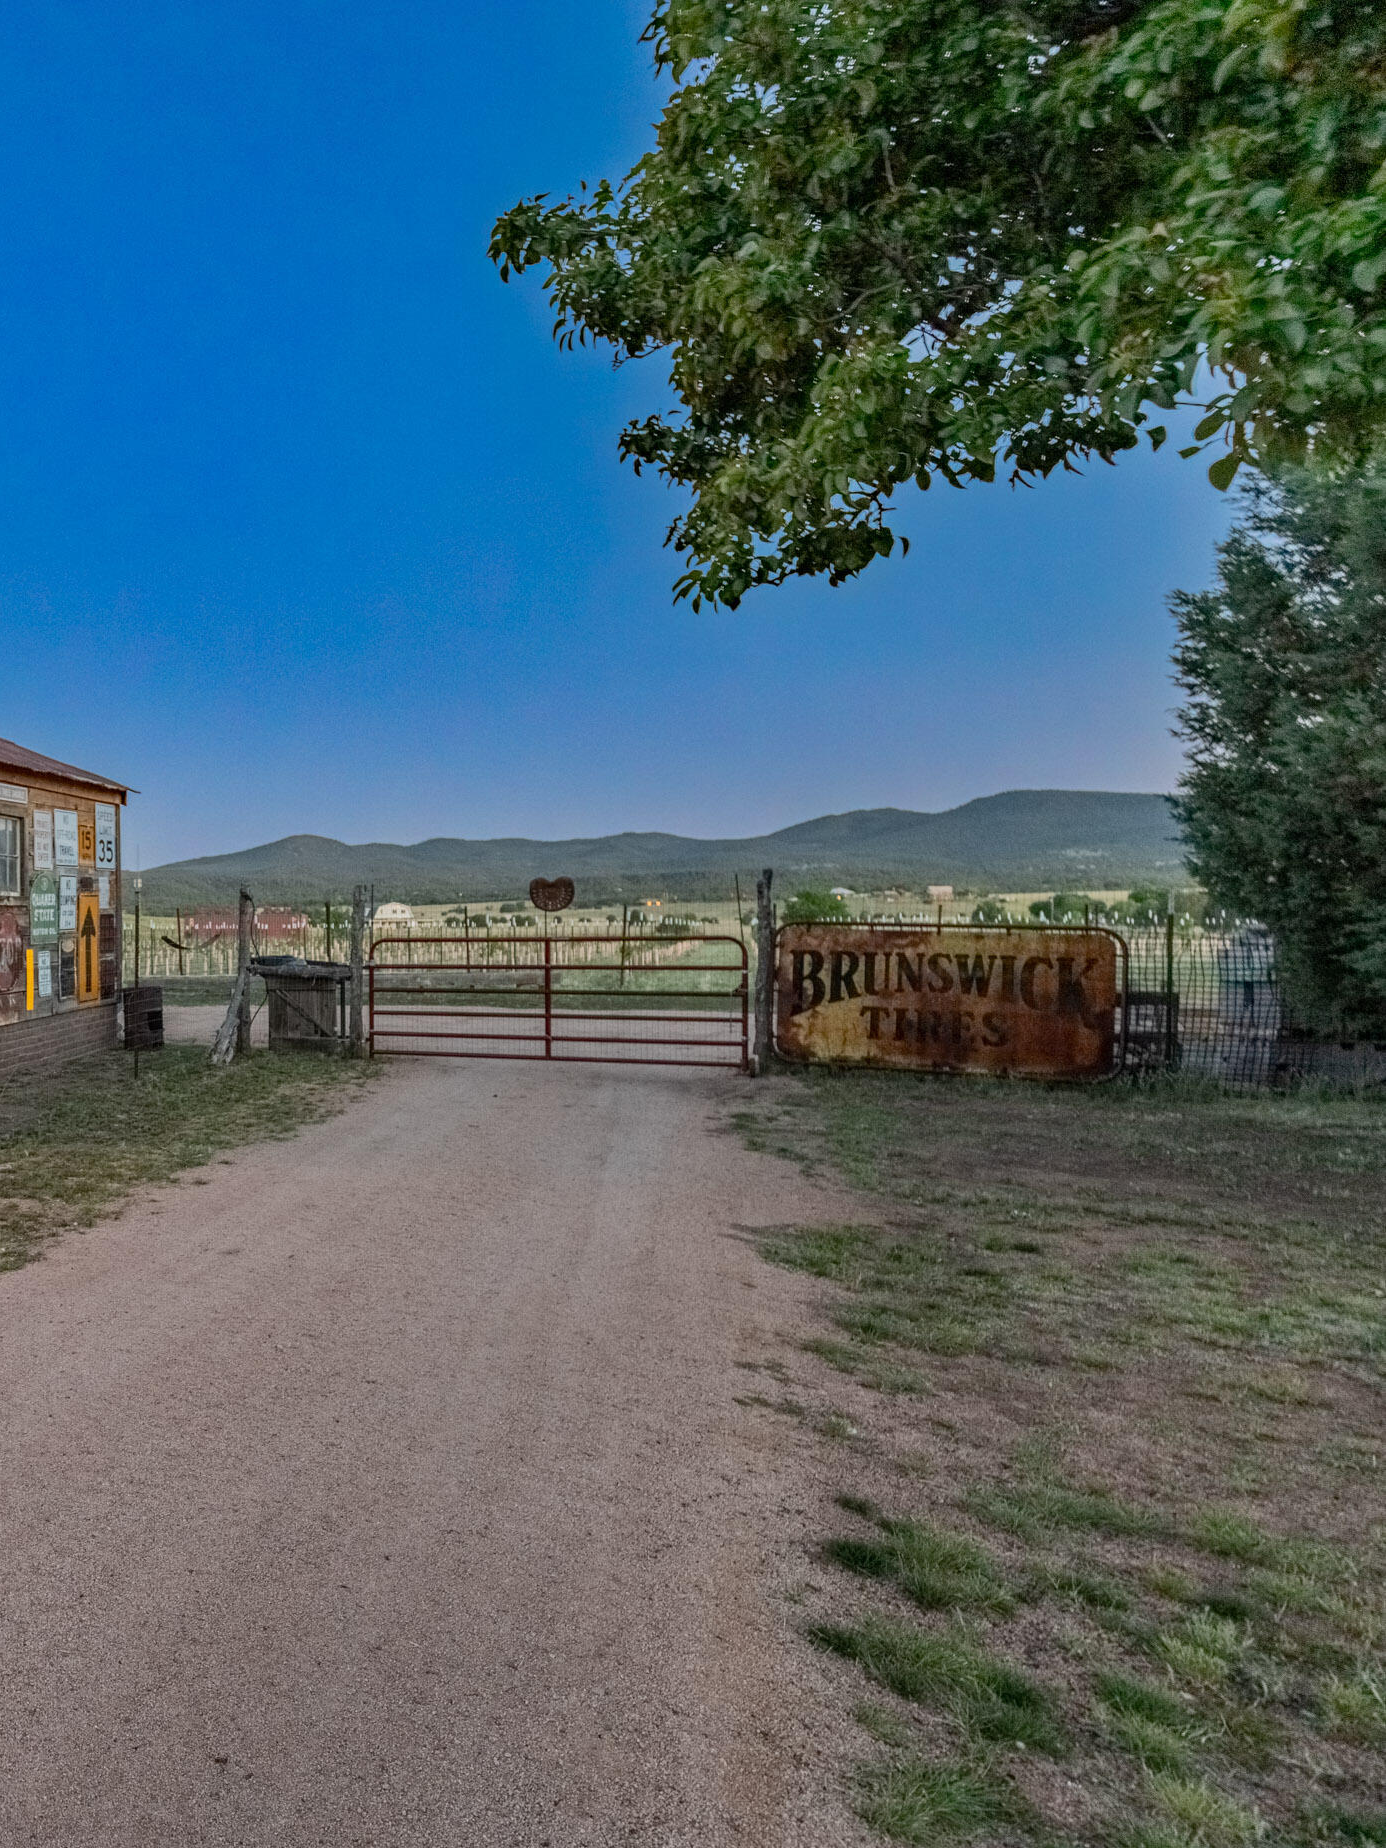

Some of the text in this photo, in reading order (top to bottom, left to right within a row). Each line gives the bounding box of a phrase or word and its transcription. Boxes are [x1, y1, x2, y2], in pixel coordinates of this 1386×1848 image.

[97, 809, 113, 822] SPEED
[82, 830, 91, 850] 15
[99, 840, 113, 862] 35
[32, 893, 56, 907] QUAKER
[34, 909, 55, 921] STATE
[790, 949, 1100, 1017] BRUNSWICK
[860, 1004, 1010, 1047] TIRES
